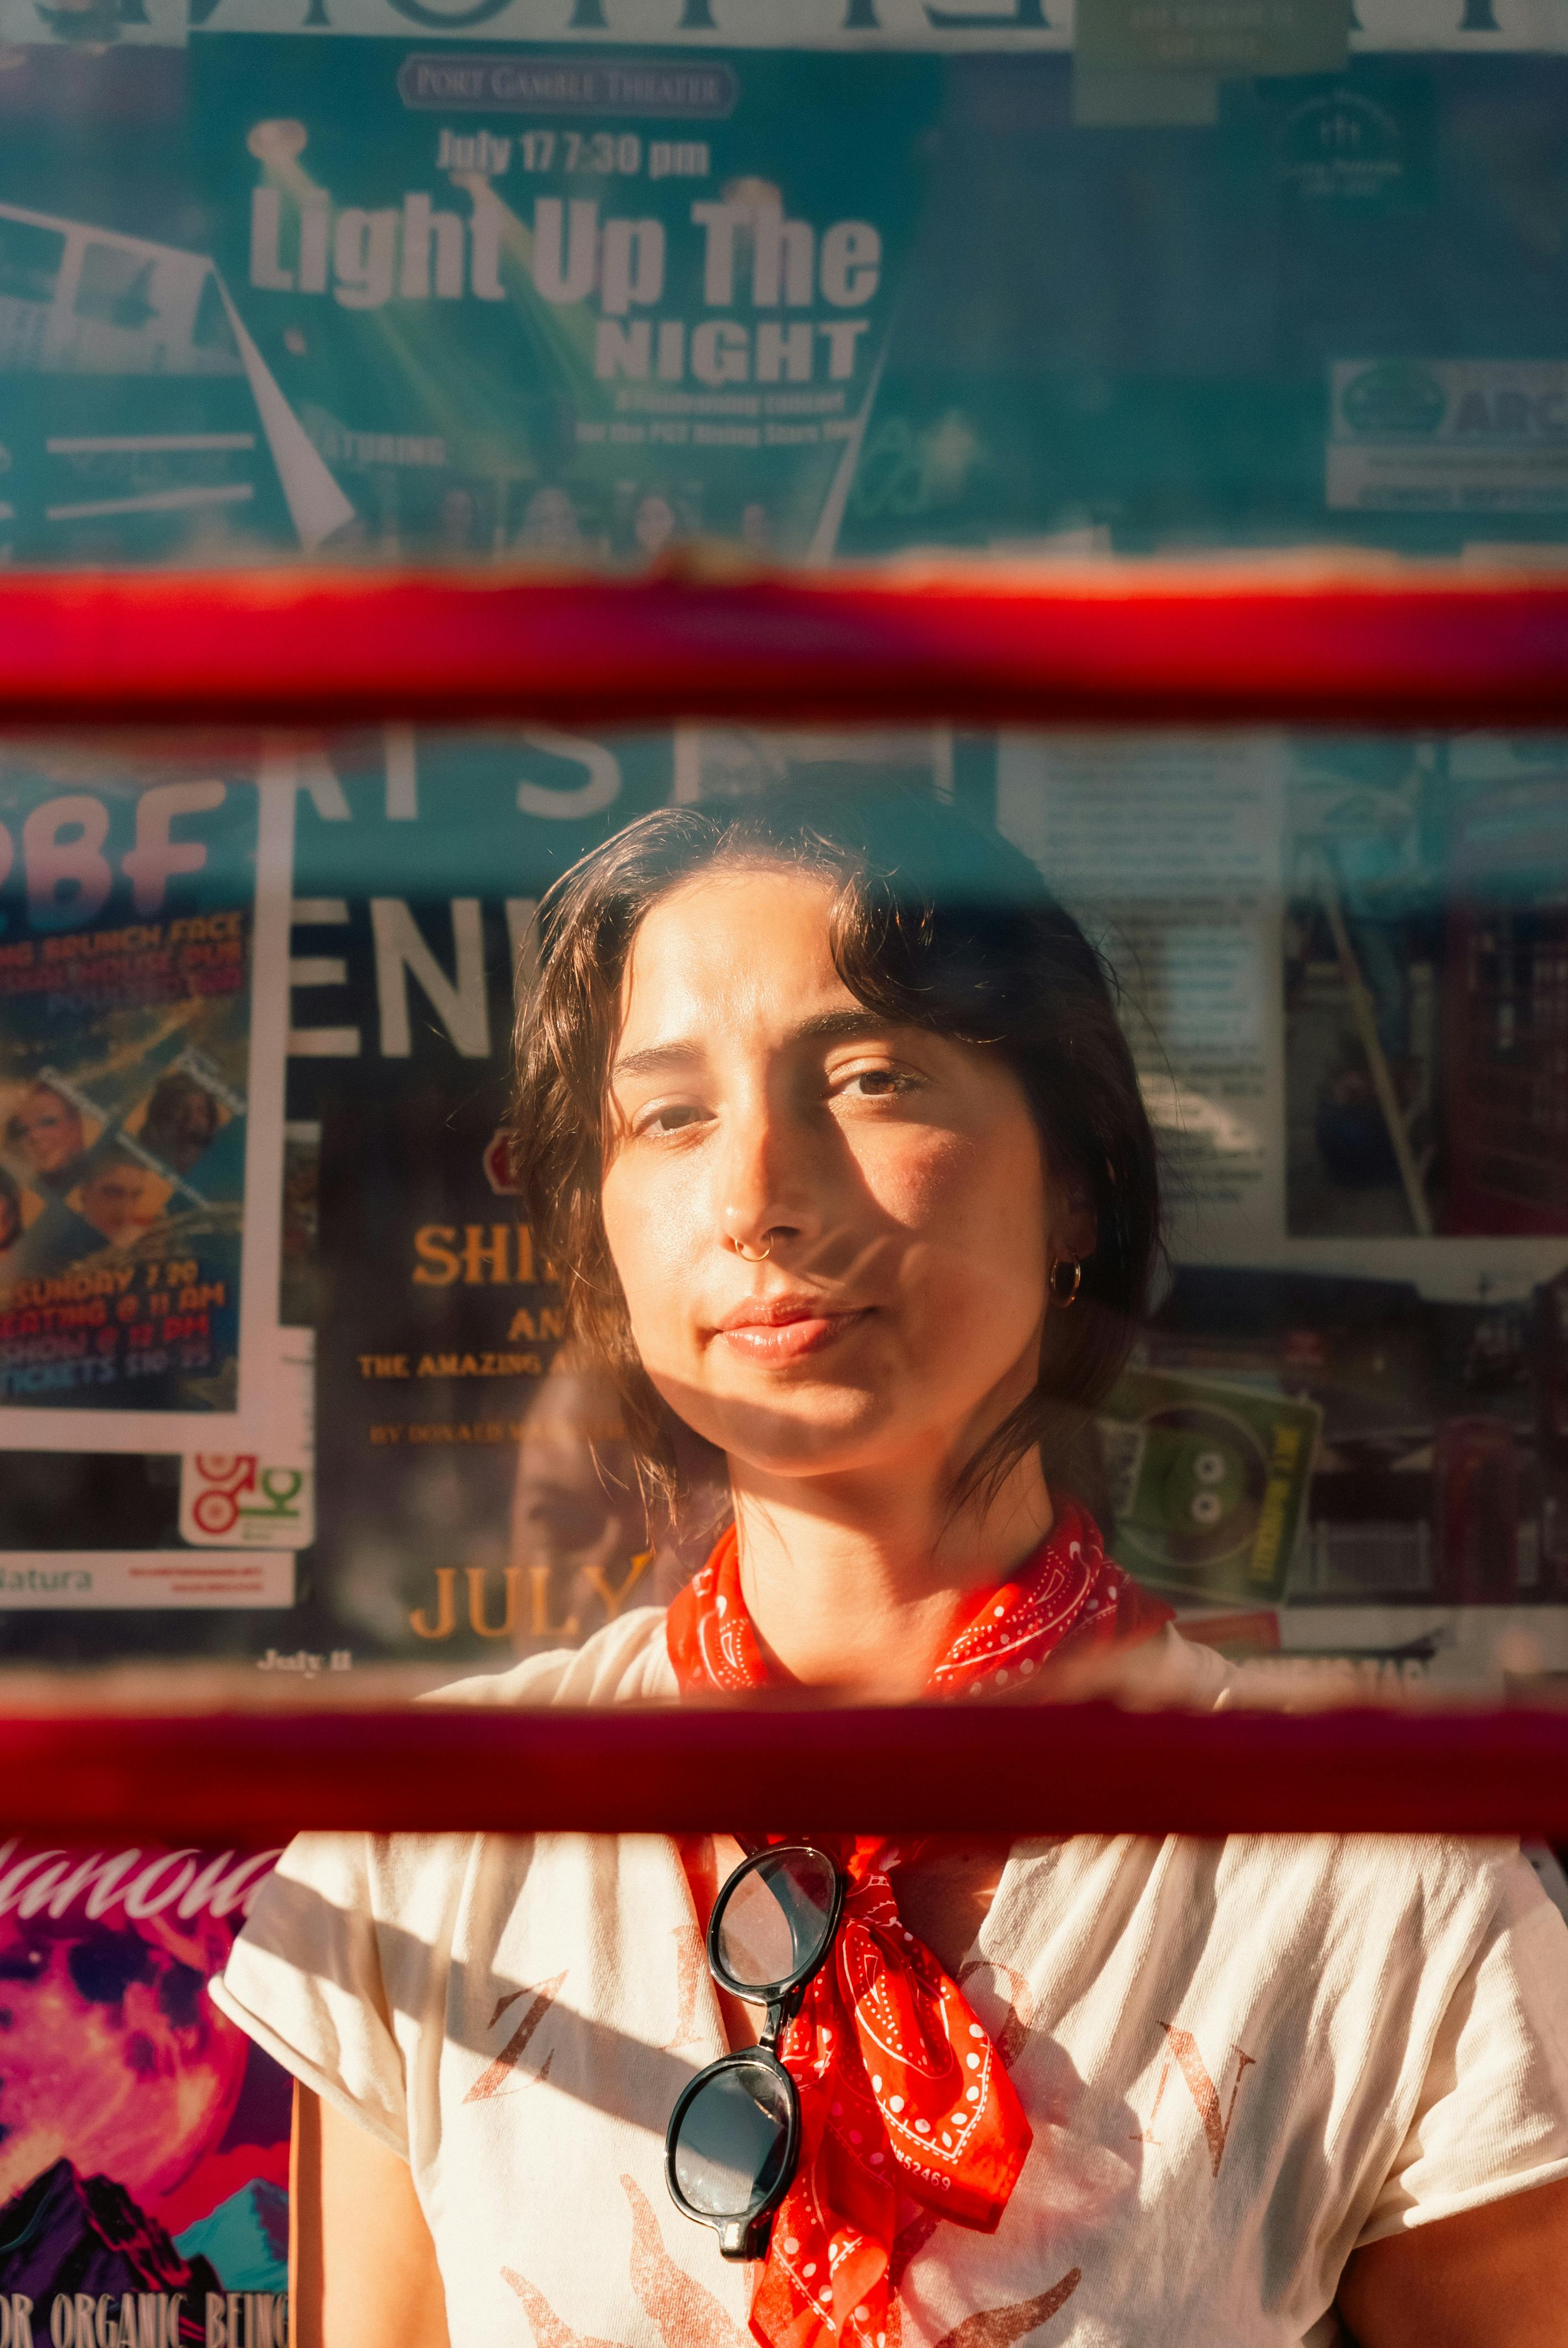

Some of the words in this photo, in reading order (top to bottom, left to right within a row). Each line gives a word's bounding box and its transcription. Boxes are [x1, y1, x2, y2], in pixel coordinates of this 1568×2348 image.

[436, 127, 512, 174] July
[520, 130, 556, 173] 17
[649, 141, 710, 181] pm
[533, 197, 666, 315] Up
[691, 198, 880, 307] The
[594, 320, 871, 386] NIGHT
[0, 778, 227, 933] BF
[178, 1283, 225, 1311] AM
[359, 1355, 409, 1377] THE
[416, 1354, 541, 1376] AMAZING
[409, 1553, 652, 1638] JULY
[256, 1647, 323, 1680] July
[50, 2293, 189, 2348] ORGANIC
